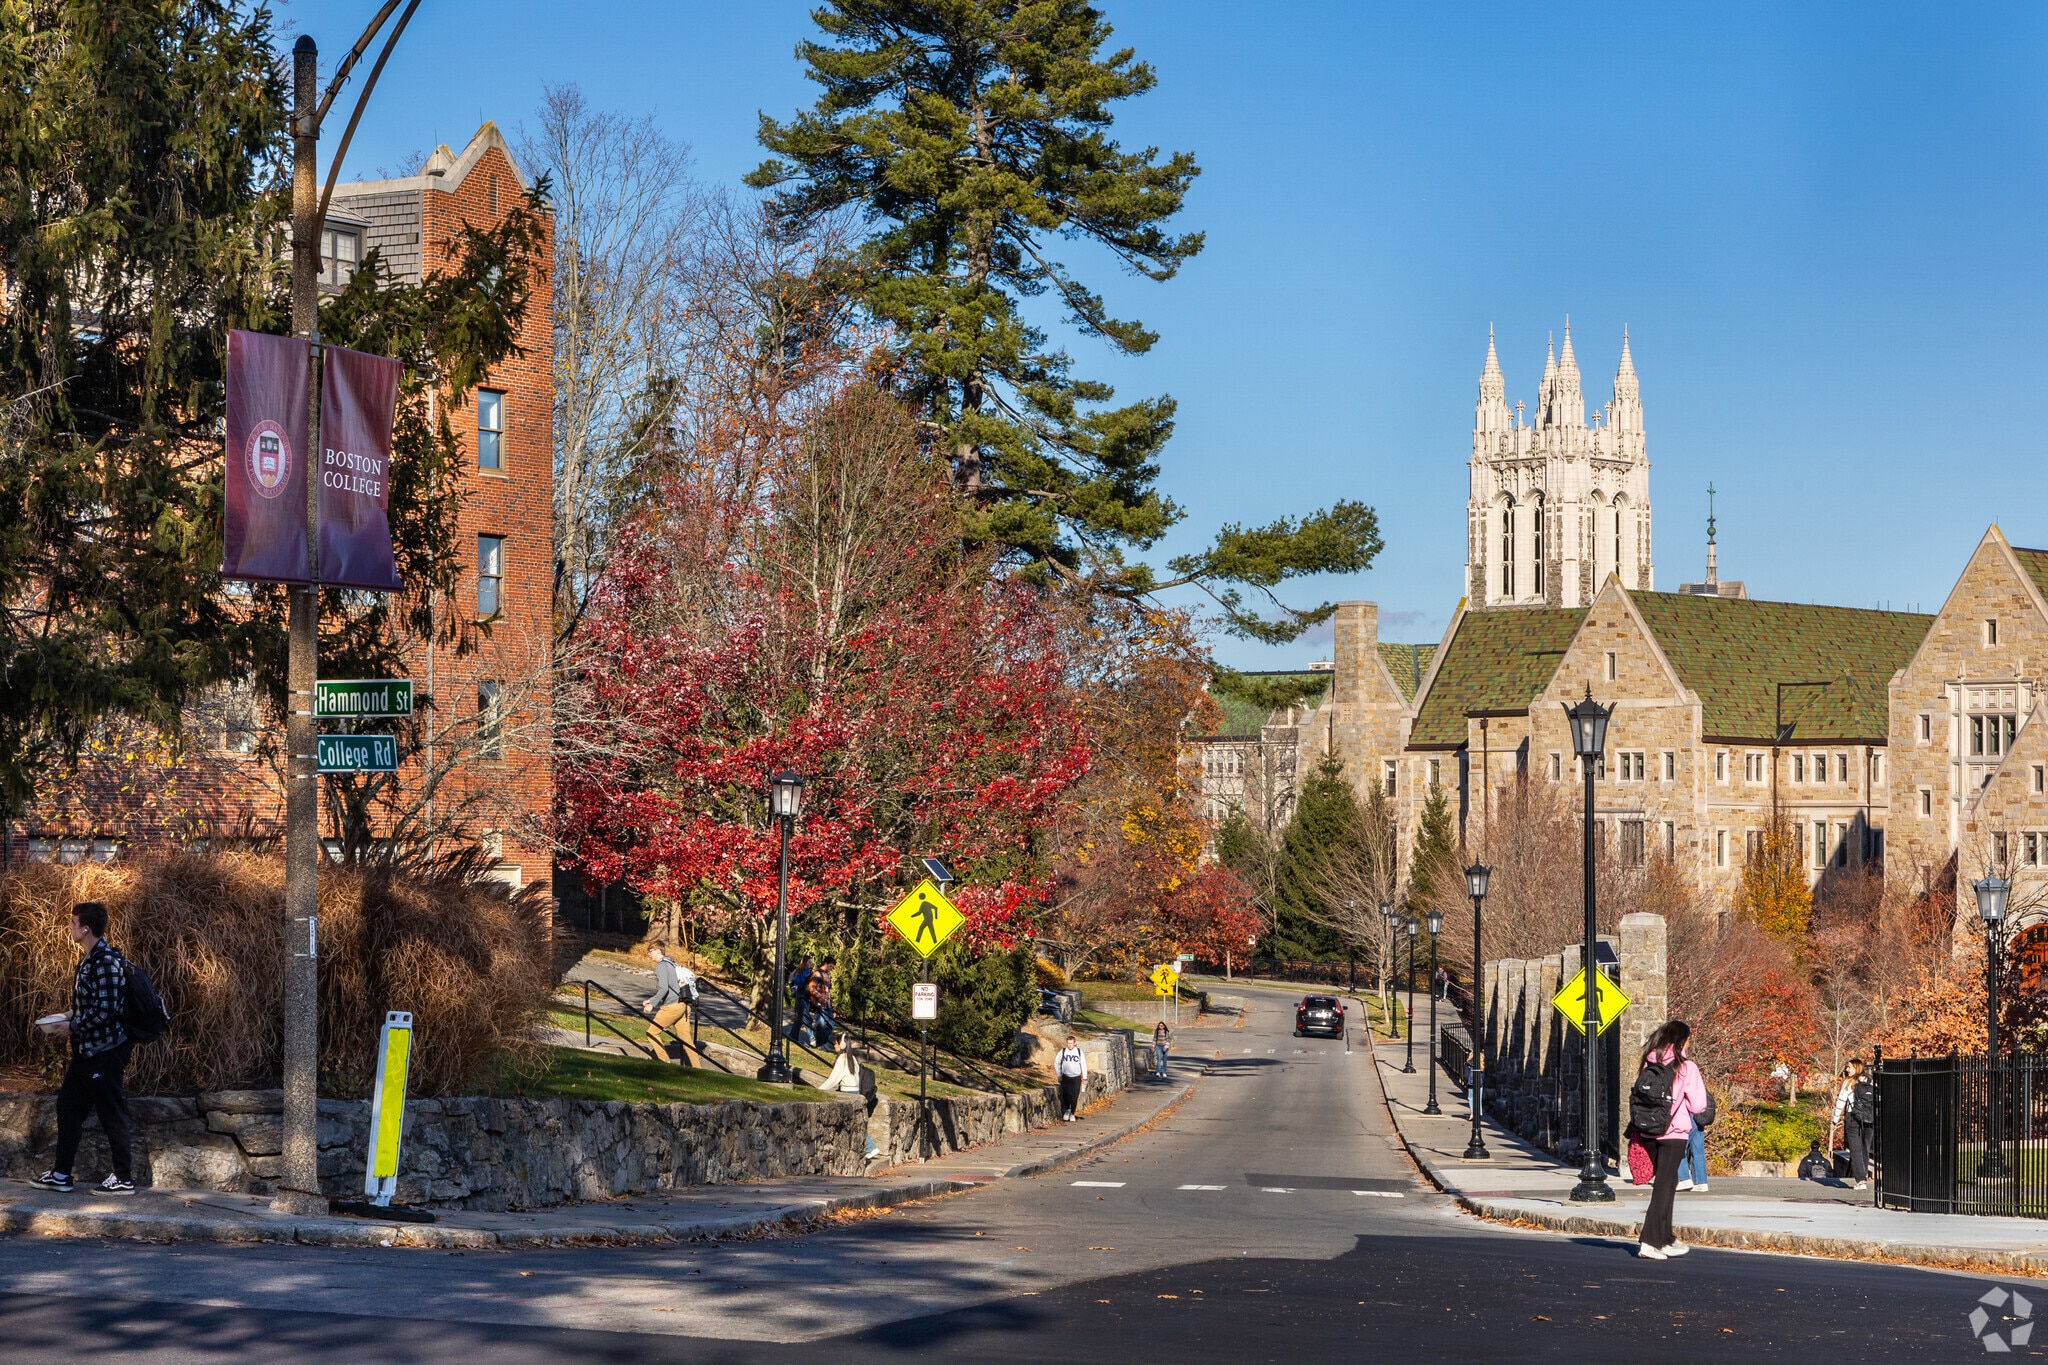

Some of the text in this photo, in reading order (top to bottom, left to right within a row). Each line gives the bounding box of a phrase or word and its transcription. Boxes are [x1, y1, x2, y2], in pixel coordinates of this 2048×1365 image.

[325, 448, 382, 475] BOSTON
[324, 471, 381, 497] COLLEGE
[319, 685, 408, 712] Hammond St
[317, 740, 392, 768] College Rd
